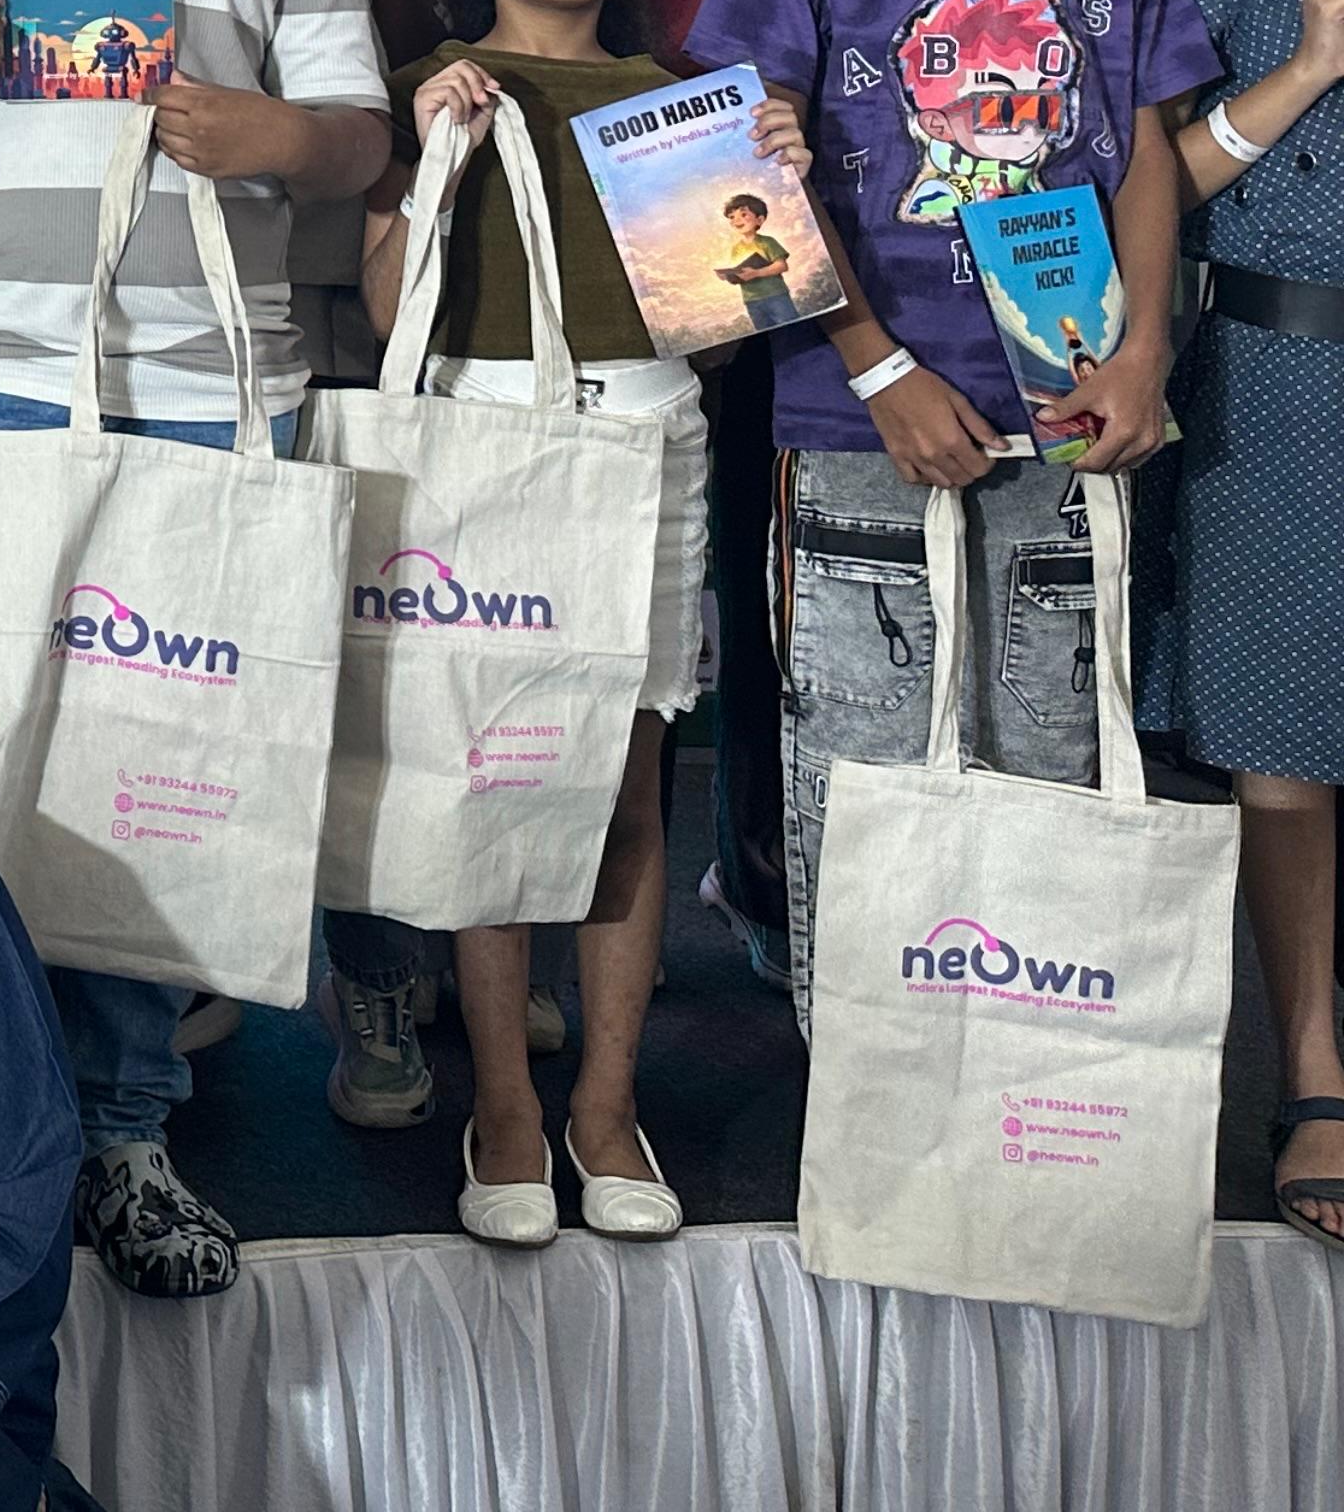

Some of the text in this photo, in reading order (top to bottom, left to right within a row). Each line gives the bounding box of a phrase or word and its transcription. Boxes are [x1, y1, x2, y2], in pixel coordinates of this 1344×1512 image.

[597, 84, 744, 148] GOOD HABITS
[616, 116, 745, 165] Written by Vedika Singh
[998, 207, 1077, 238] RAYYAN'S
[1012, 235, 1081, 265] MIRACLE
[1035, 265, 1075, 291] KICK!
[352, 577, 552, 629] neOwn
[49, 610, 240, 675] neOwn
[68, 651, 115, 667] Largest
[116, 657, 169, 679] Reading
[171, 668, 237, 688] Ecosystem
[902, 938, 1116, 1000] neOwn
[946, 982, 989, 998] Largest
[990, 987, 1045, 1008] Reading
[1046, 995, 1117, 1014] Ecosystem
